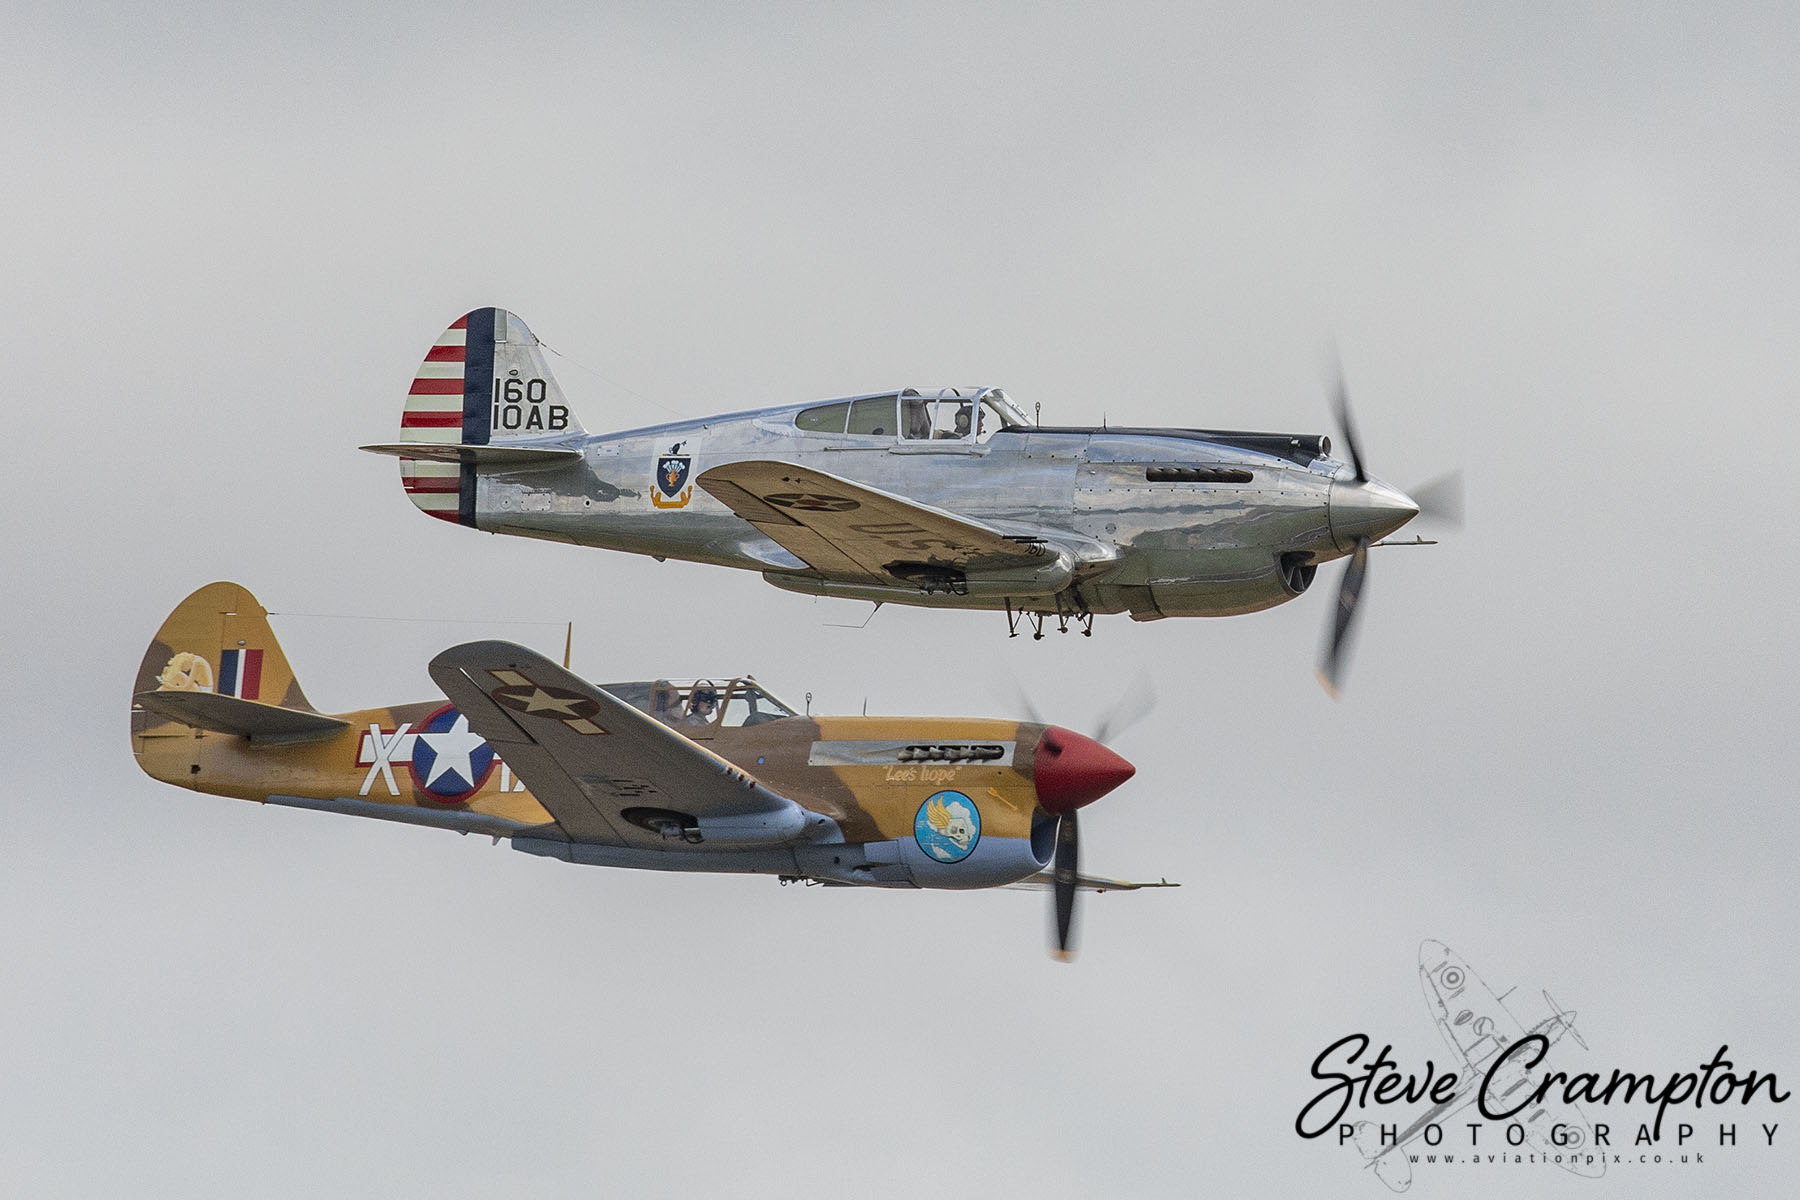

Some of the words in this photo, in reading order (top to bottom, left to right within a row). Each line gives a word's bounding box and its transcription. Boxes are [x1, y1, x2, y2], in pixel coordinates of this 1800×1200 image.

[494, 378, 546, 403] 160
[493, 405, 569, 430] 10AB
[358, 723, 413, 796] X
